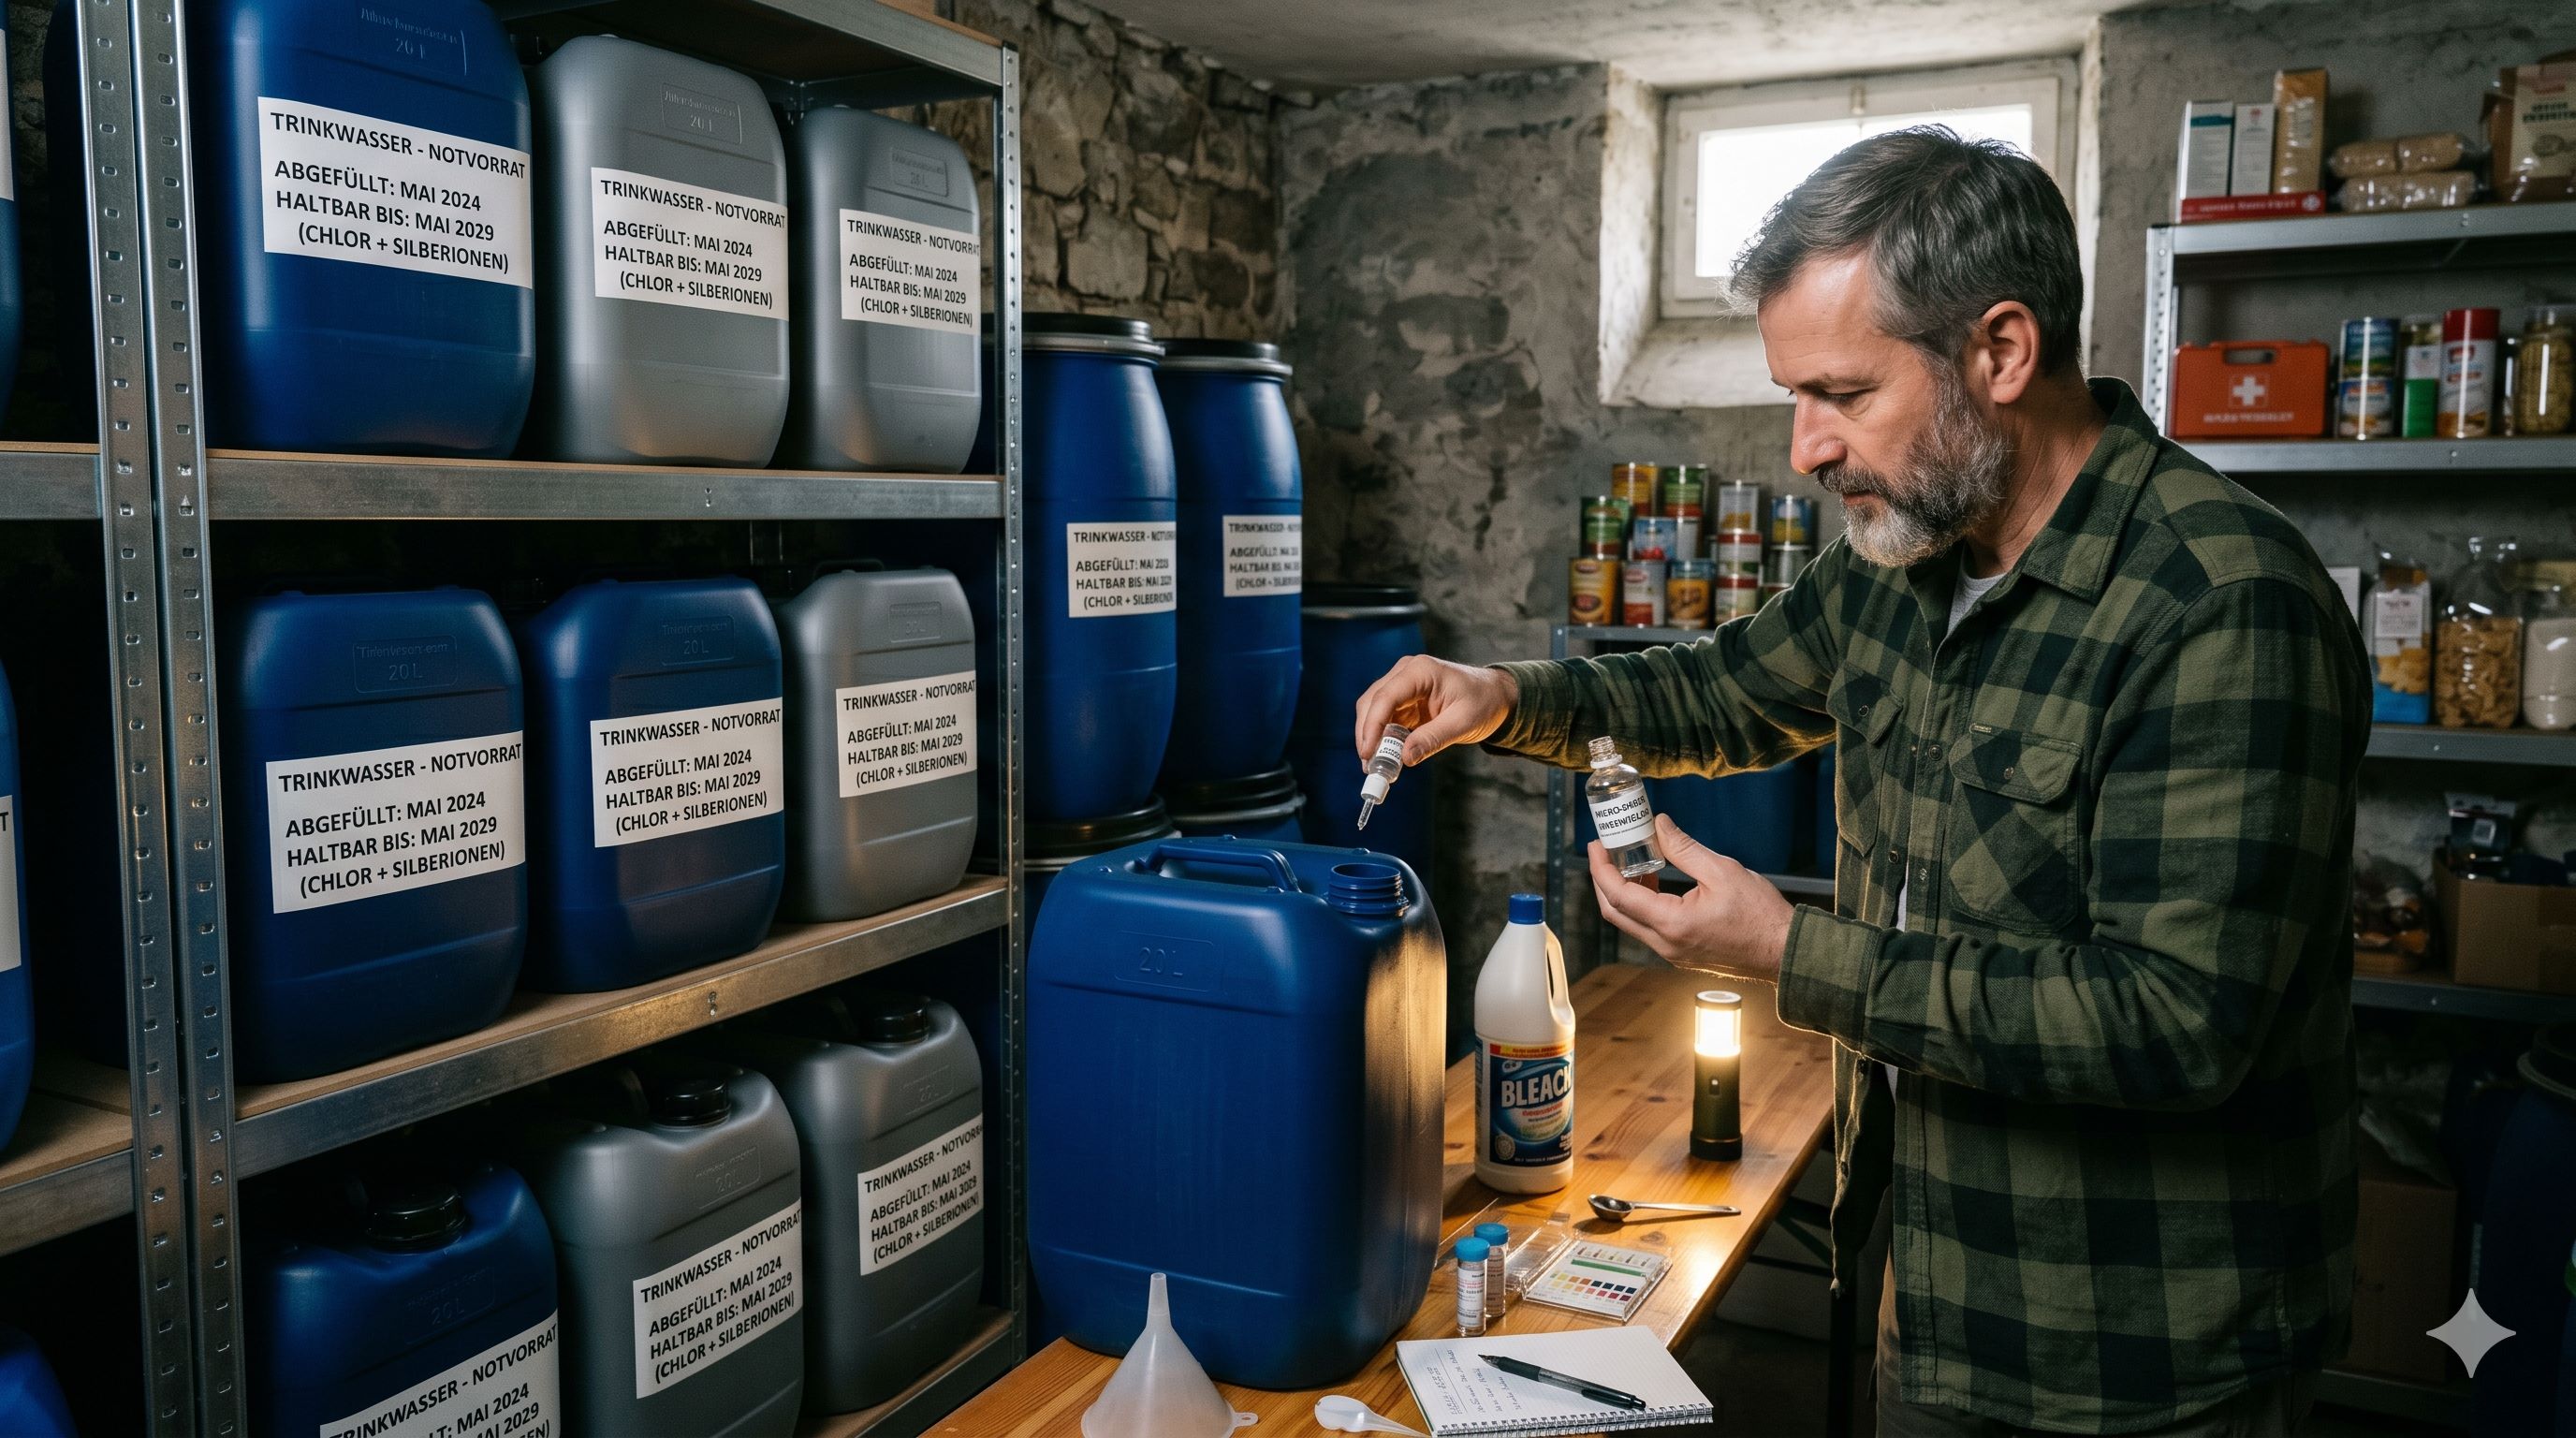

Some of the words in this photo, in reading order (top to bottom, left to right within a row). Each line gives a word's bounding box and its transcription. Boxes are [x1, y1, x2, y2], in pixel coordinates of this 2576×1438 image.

[270, 111, 412, 155] TRINKWASSER
[429, 142, 526, 180] NOTVORRAT
[274, 160, 395, 196] ABGEFÜLLT:
[401, 181, 435, 203] MAI
[441, 189, 481, 212] 2024
[600, 179, 704, 213] TRINKWASSER
[715, 202, 785, 228] NOTVORRAT
[275, 190, 371, 221] HALTBAR
[376, 205, 410, 227] BIS:
[416, 213, 450, 234] MAI
[455, 219, 494, 242] 2029
[847, 219, 922, 245] TRINKWASSER
[298, 222, 372, 250] (CHLOR
[376, 240, 388, 251] +
[393, 237, 509, 274] SILBERIONEN)
[604, 219, 691, 247] ABGEFÜLLT:
[695, 235, 721, 252] MAI
[724, 240, 753, 258] 2024
[605, 245, 674, 270] HALTBAR
[678, 255, 701, 272] BIS:
[705, 260, 730, 277] MAI
[733, 264, 762, 282] 2029
[850, 252, 912, 275] ABGEFÜLLT:
[915, 265, 934, 279] MAI
[936, 268, 958, 283] 2024
[620, 271, 674, 294] (CHLOR
[677, 283, 685, 292] +
[687, 281, 773, 311] SILBERIONEN)
[850, 274, 900, 294] HALTBAR
[902, 282, 921, 297] BIS:
[923, 286, 943, 301] MAI
[944, 289, 966, 304] 2029
[860, 296, 899, 315] (CHLOR
[901, 306, 908, 315] +
[910, 303, 973, 328] SILBERIONEN)
[1074, 531, 1146, 543] TRINKWASSER
[1076, 557, 1138, 572] ABGEFÜLLT:
[1076, 577, 1126, 590] HALTBAR
[1084, 595, 1123, 610] (CHLOR
[388, 663, 410, 682] 20
[842, 689, 917, 712] TRINKWASSER
[925, 680, 975, 700] NOTVORRAT
[599, 721, 700, 747] TRINKWASSER
[711, 709, 781, 732] NOTVORRAT
[847, 722, 912, 744] ABGEFÜLLT:
[914, 717, 933, 732] MAI
[935, 714, 957, 728] 2024
[278, 759, 416, 792] TRINKWASSER
[431, 742, 521, 772] NOTVORRAT
[605, 758, 690, 785] ABGEFÜLLT:
[694, 753, 720, 771] MAI
[723, 749, 752, 767] 2024
[847, 744, 899, 766] HALTBAR
[900, 740, 919, 755] BIS:
[921, 736, 940, 751] MAI
[942, 732, 962, 747] 2029
[856, 766, 895, 788] (CHLOR
[898, 768, 903, 777] +
[905, 751, 968, 777] SILBERIONEN)
[606, 786, 673, 810] HALTBAR
[677, 781, 701, 798] BIS:
[704, 776, 730, 794] MAI
[733, 770, 761, 788] 2029
[285, 805, 402, 838] ABGEFÜLLT:
[406, 797, 442, 820] MAI
[446, 791, 486, 814] 2024
[615, 809, 667, 837] (CHLOR
[672, 811, 681, 821] +
[683, 790, 768, 822] SILBERIONEN)
[286, 837, 377, 868] HALTBAR
[383, 831, 416, 853] BIS:
[420, 824, 454, 846] MAI
[459, 816, 497, 839] 2029
[300, 866, 373, 899] (CHLOR
[377, 868, 388, 880] +
[392, 840, 505, 878] SILBERIONEN)
[865, 1152, 935, 1194] TRINKWASSER
[870, 1184, 930, 1223] ABGEFÜLLT:
[932, 1171, 950, 1191] MAI
[952, 1159, 972, 1181] 2024
[871, 1211, 918, 1243] HALTBAR
[921, 1199, 938, 1218] BIS:
[940, 1187, 958, 1208] MAI
[873, 1233, 914, 1265] (CHLOR
[915, 1230, 921, 1240] +
[640, 1249, 732, 1304] TRINKWASSER
[649, 1286, 728, 1337] ABGEFÜLLT:
[730, 1272, 754, 1297] MAI
[756, 1255, 782, 1283] 2024
[650, 1320, 713, 1359] HALTBAR
[716, 1305, 739, 1328] BIS:
[741, 1288, 766, 1313] MAI
[768, 1272, 792, 1298] 2029
[472, 1324, 557, 1386] NOTVORRAT
[654, 1343, 707, 1384] (CHLOR
[709, 1341, 716, 1351] +
[718, 1290, 796, 1346] SILBERIONEN)
[457, 1403, 489, 1434] MAI
[492, 1383, 530, 1415] 2024
[504, 1401, 539, 1435] 2029
